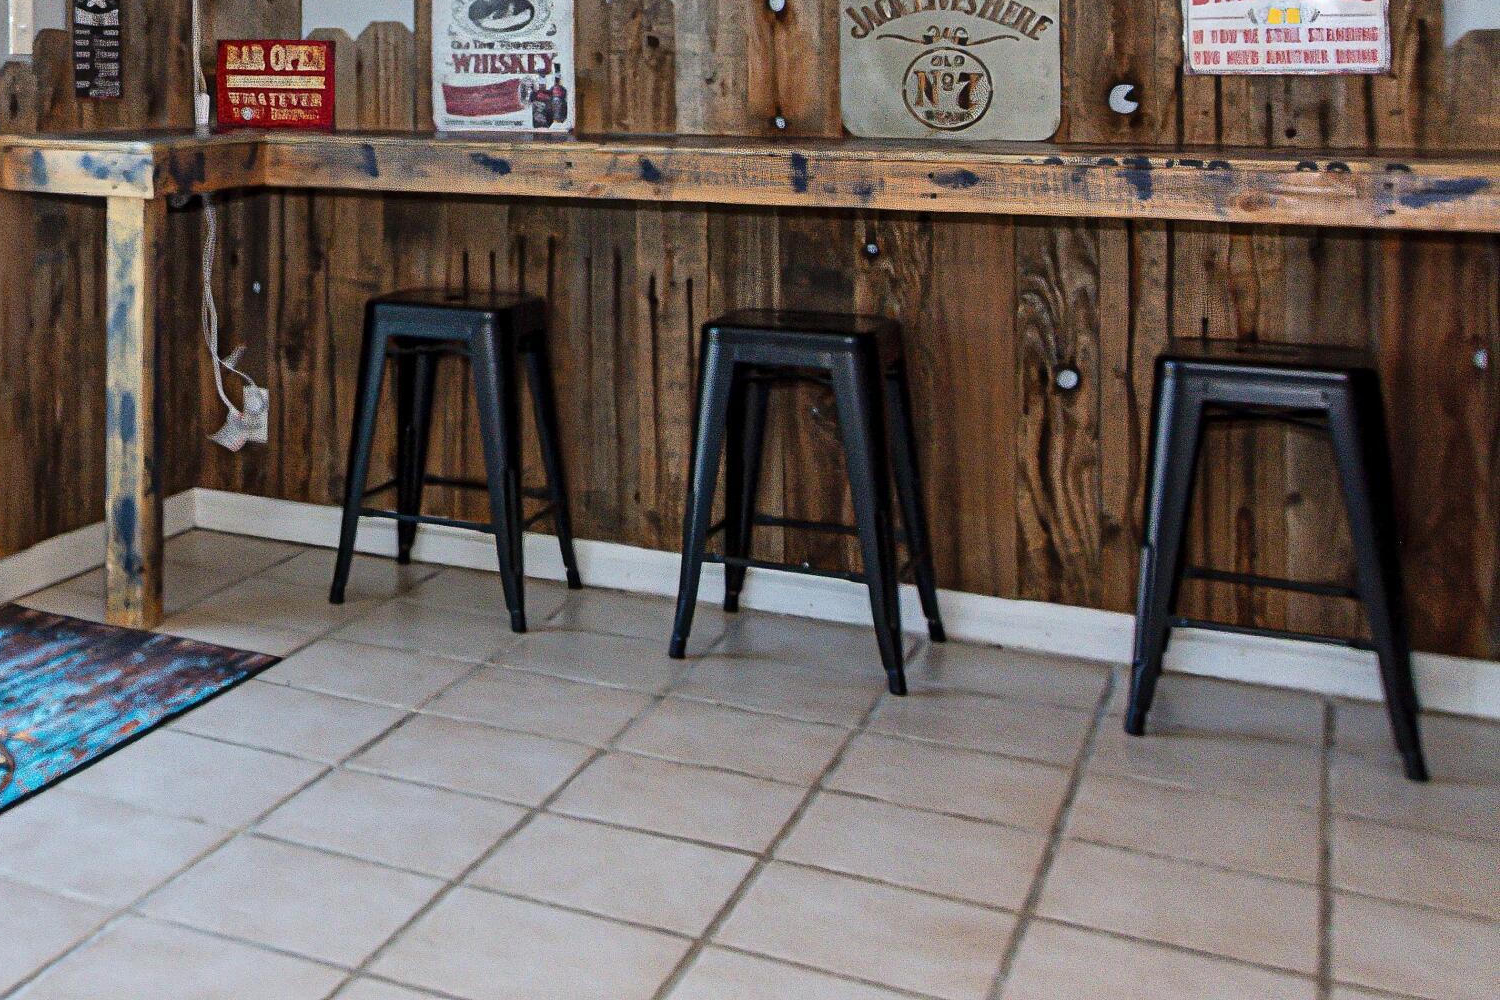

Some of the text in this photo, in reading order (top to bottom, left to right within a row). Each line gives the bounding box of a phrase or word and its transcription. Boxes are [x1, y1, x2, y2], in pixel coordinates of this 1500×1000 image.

[226, 44, 326, 71] BAR OPEN
[451, 53, 558, 75] WHISKEY
[930, 54, 966, 67] OLD
[957, 72, 984, 111] 7
